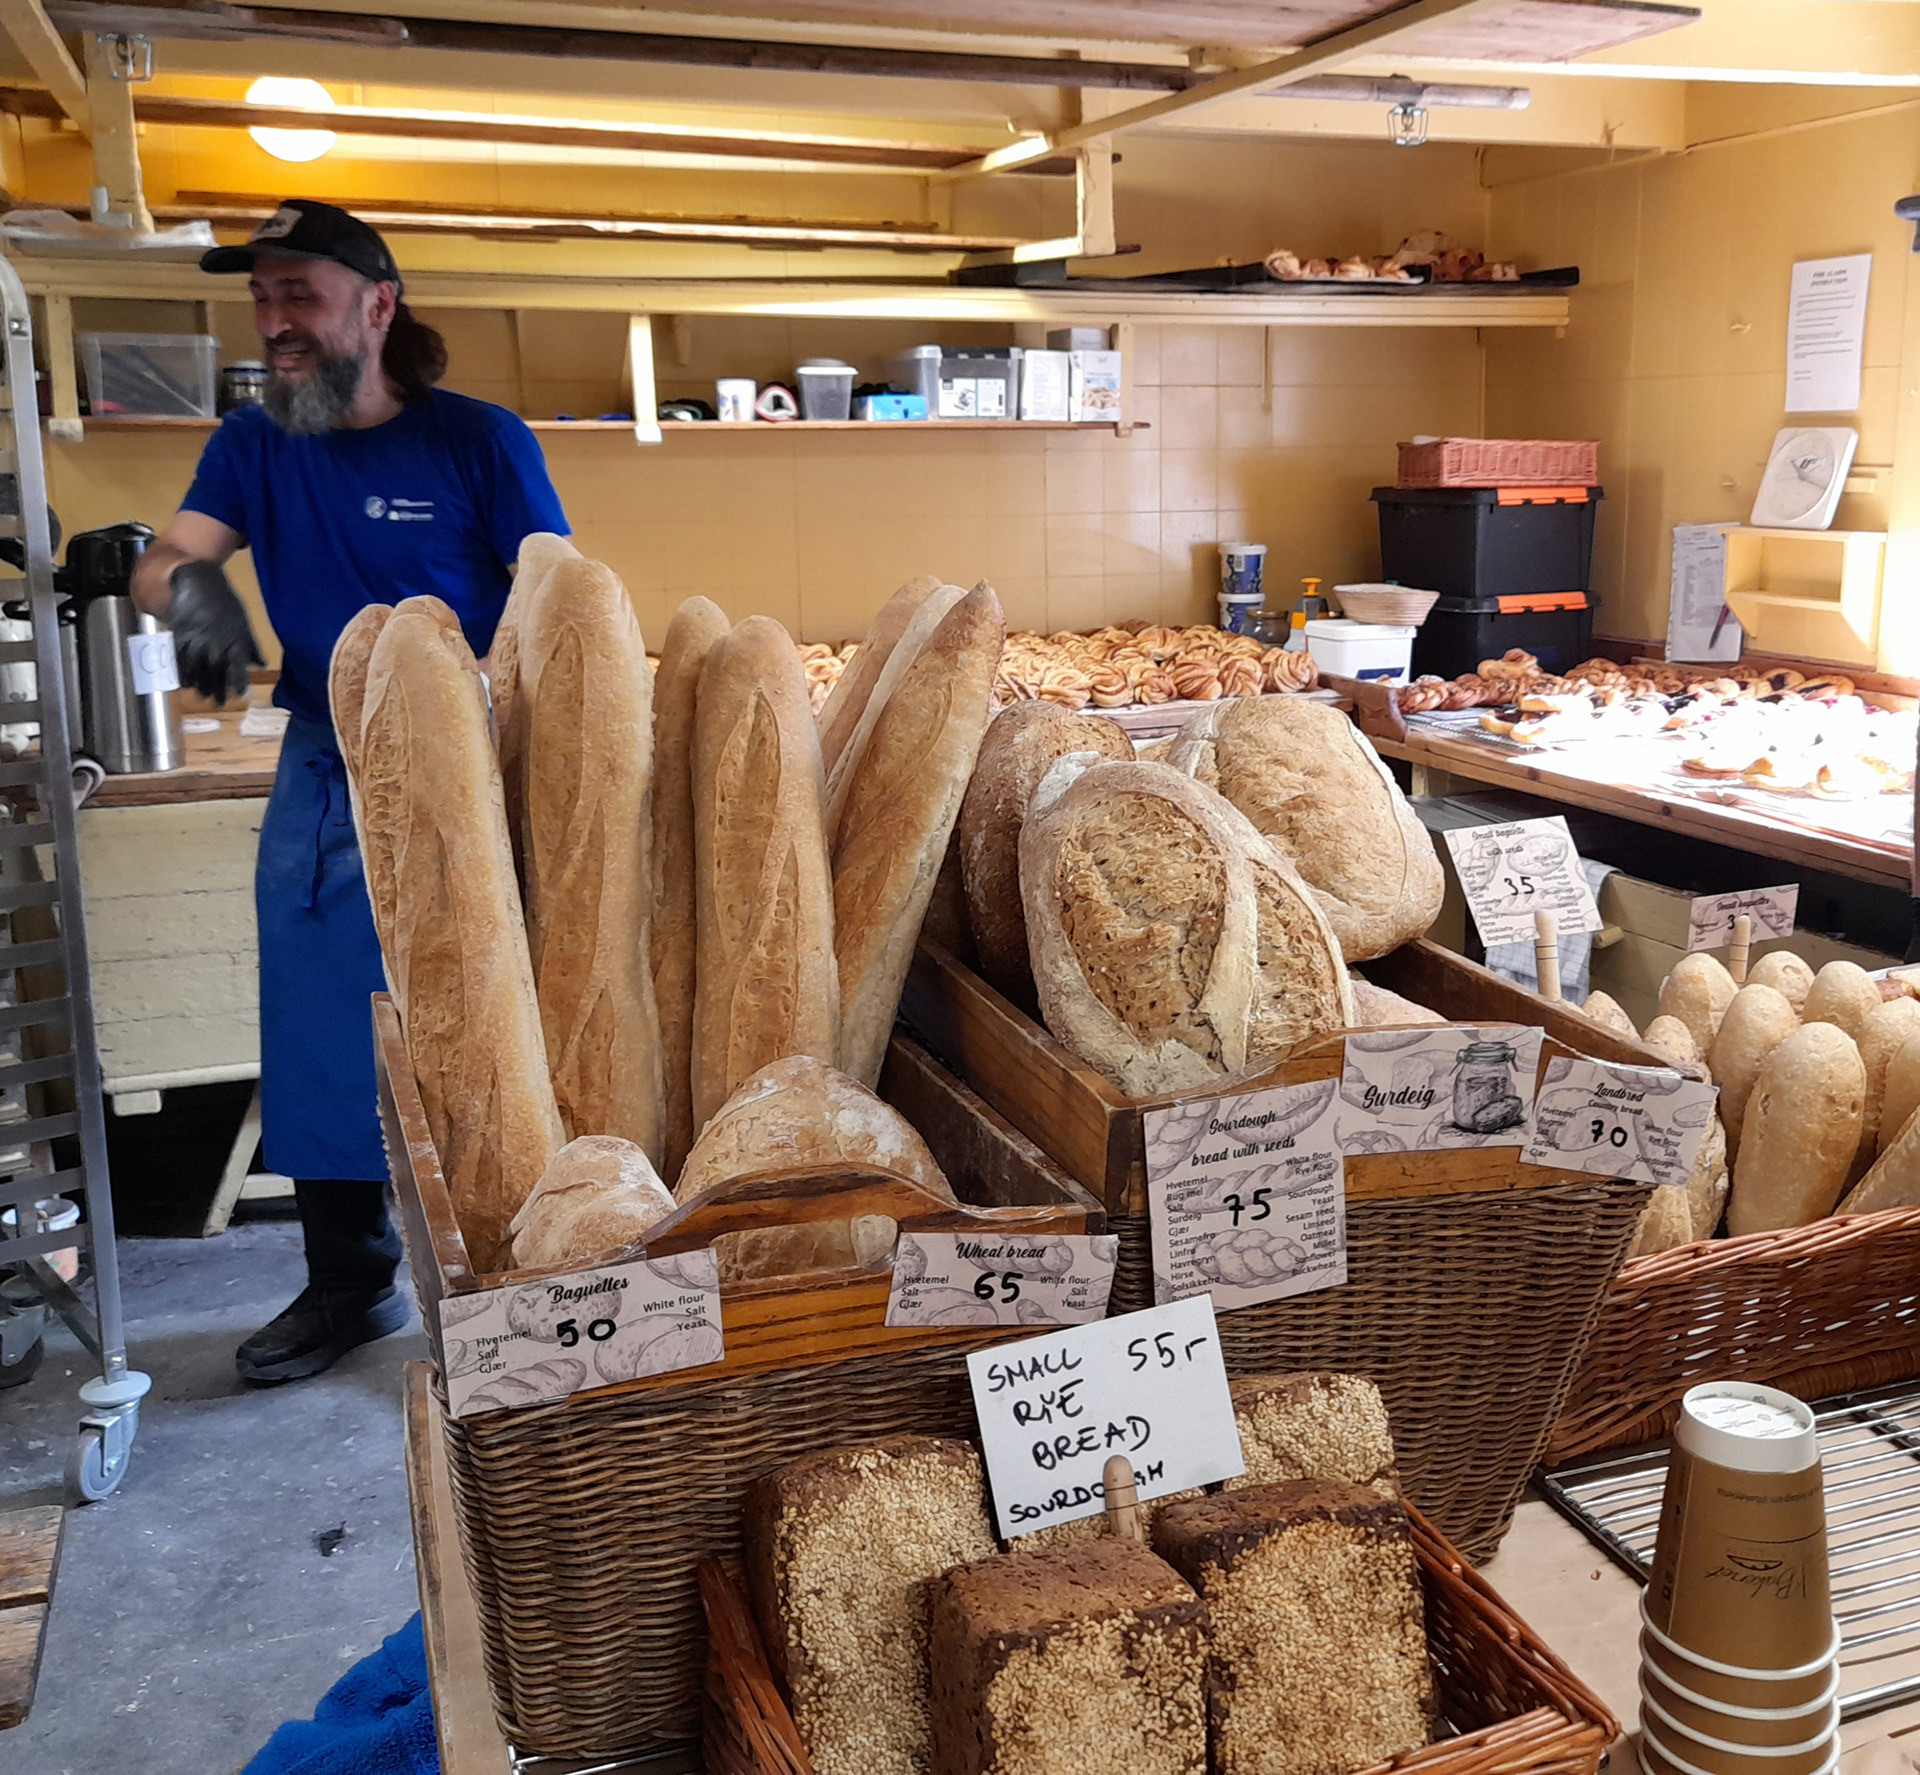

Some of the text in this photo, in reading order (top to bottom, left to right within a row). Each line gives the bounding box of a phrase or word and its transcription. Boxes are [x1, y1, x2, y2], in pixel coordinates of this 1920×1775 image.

[1504, 876, 1535, 896] 35
[1362, 1084, 1436, 1110] Surdeig
[1619, 1104, 1644, 1116] bread
[1209, 1110, 1276, 1136] Sourdough
[1590, 1119, 1629, 1148] 70
[1192, 1136, 1296, 1167] bread with seeds
[1166, 1175, 1208, 1190] Hvetemel
[1288, 1183, 1334, 1200] Sourdough
[1223, 1188, 1272, 1226] 75
[1311, 1195, 1335, 1206] Yeast
[1167, 1212, 1202, 1225] Surdeig
[1315, 1205, 1335, 1217] seed
[1303, 1216, 1336, 1230] Linseed
[1300, 1227, 1336, 1241] Oatmeal
[955, 1242, 1046, 1260] Wheat bread
[1040, 1275, 1091, 1285] White flour
[1170, 1271, 1194, 1281] Hirse
[547, 1275, 630, 1305] Baguettes
[901, 1287, 919, 1297] Salt
[974, 1271, 1024, 1304] 65
[1071, 1287, 1088, 1296] Salt
[643, 1293, 706, 1313] White flour
[685, 1305, 706, 1318] Salt
[1061, 1299, 1086, 1309] Yeast
[556, 1318, 617, 1347] 50
[677, 1319, 708, 1332] Yeast
[476, 1327, 532, 1348] Hvetemel
[477, 1349, 500, 1361] Salt
[987, 1348, 1082, 1393] SMALL
[1012, 1378, 1084, 1426] RYE
[1032, 1415, 1151, 1470] BREAD
[1009, 1460, 1164, 1524] SOURDOGH
